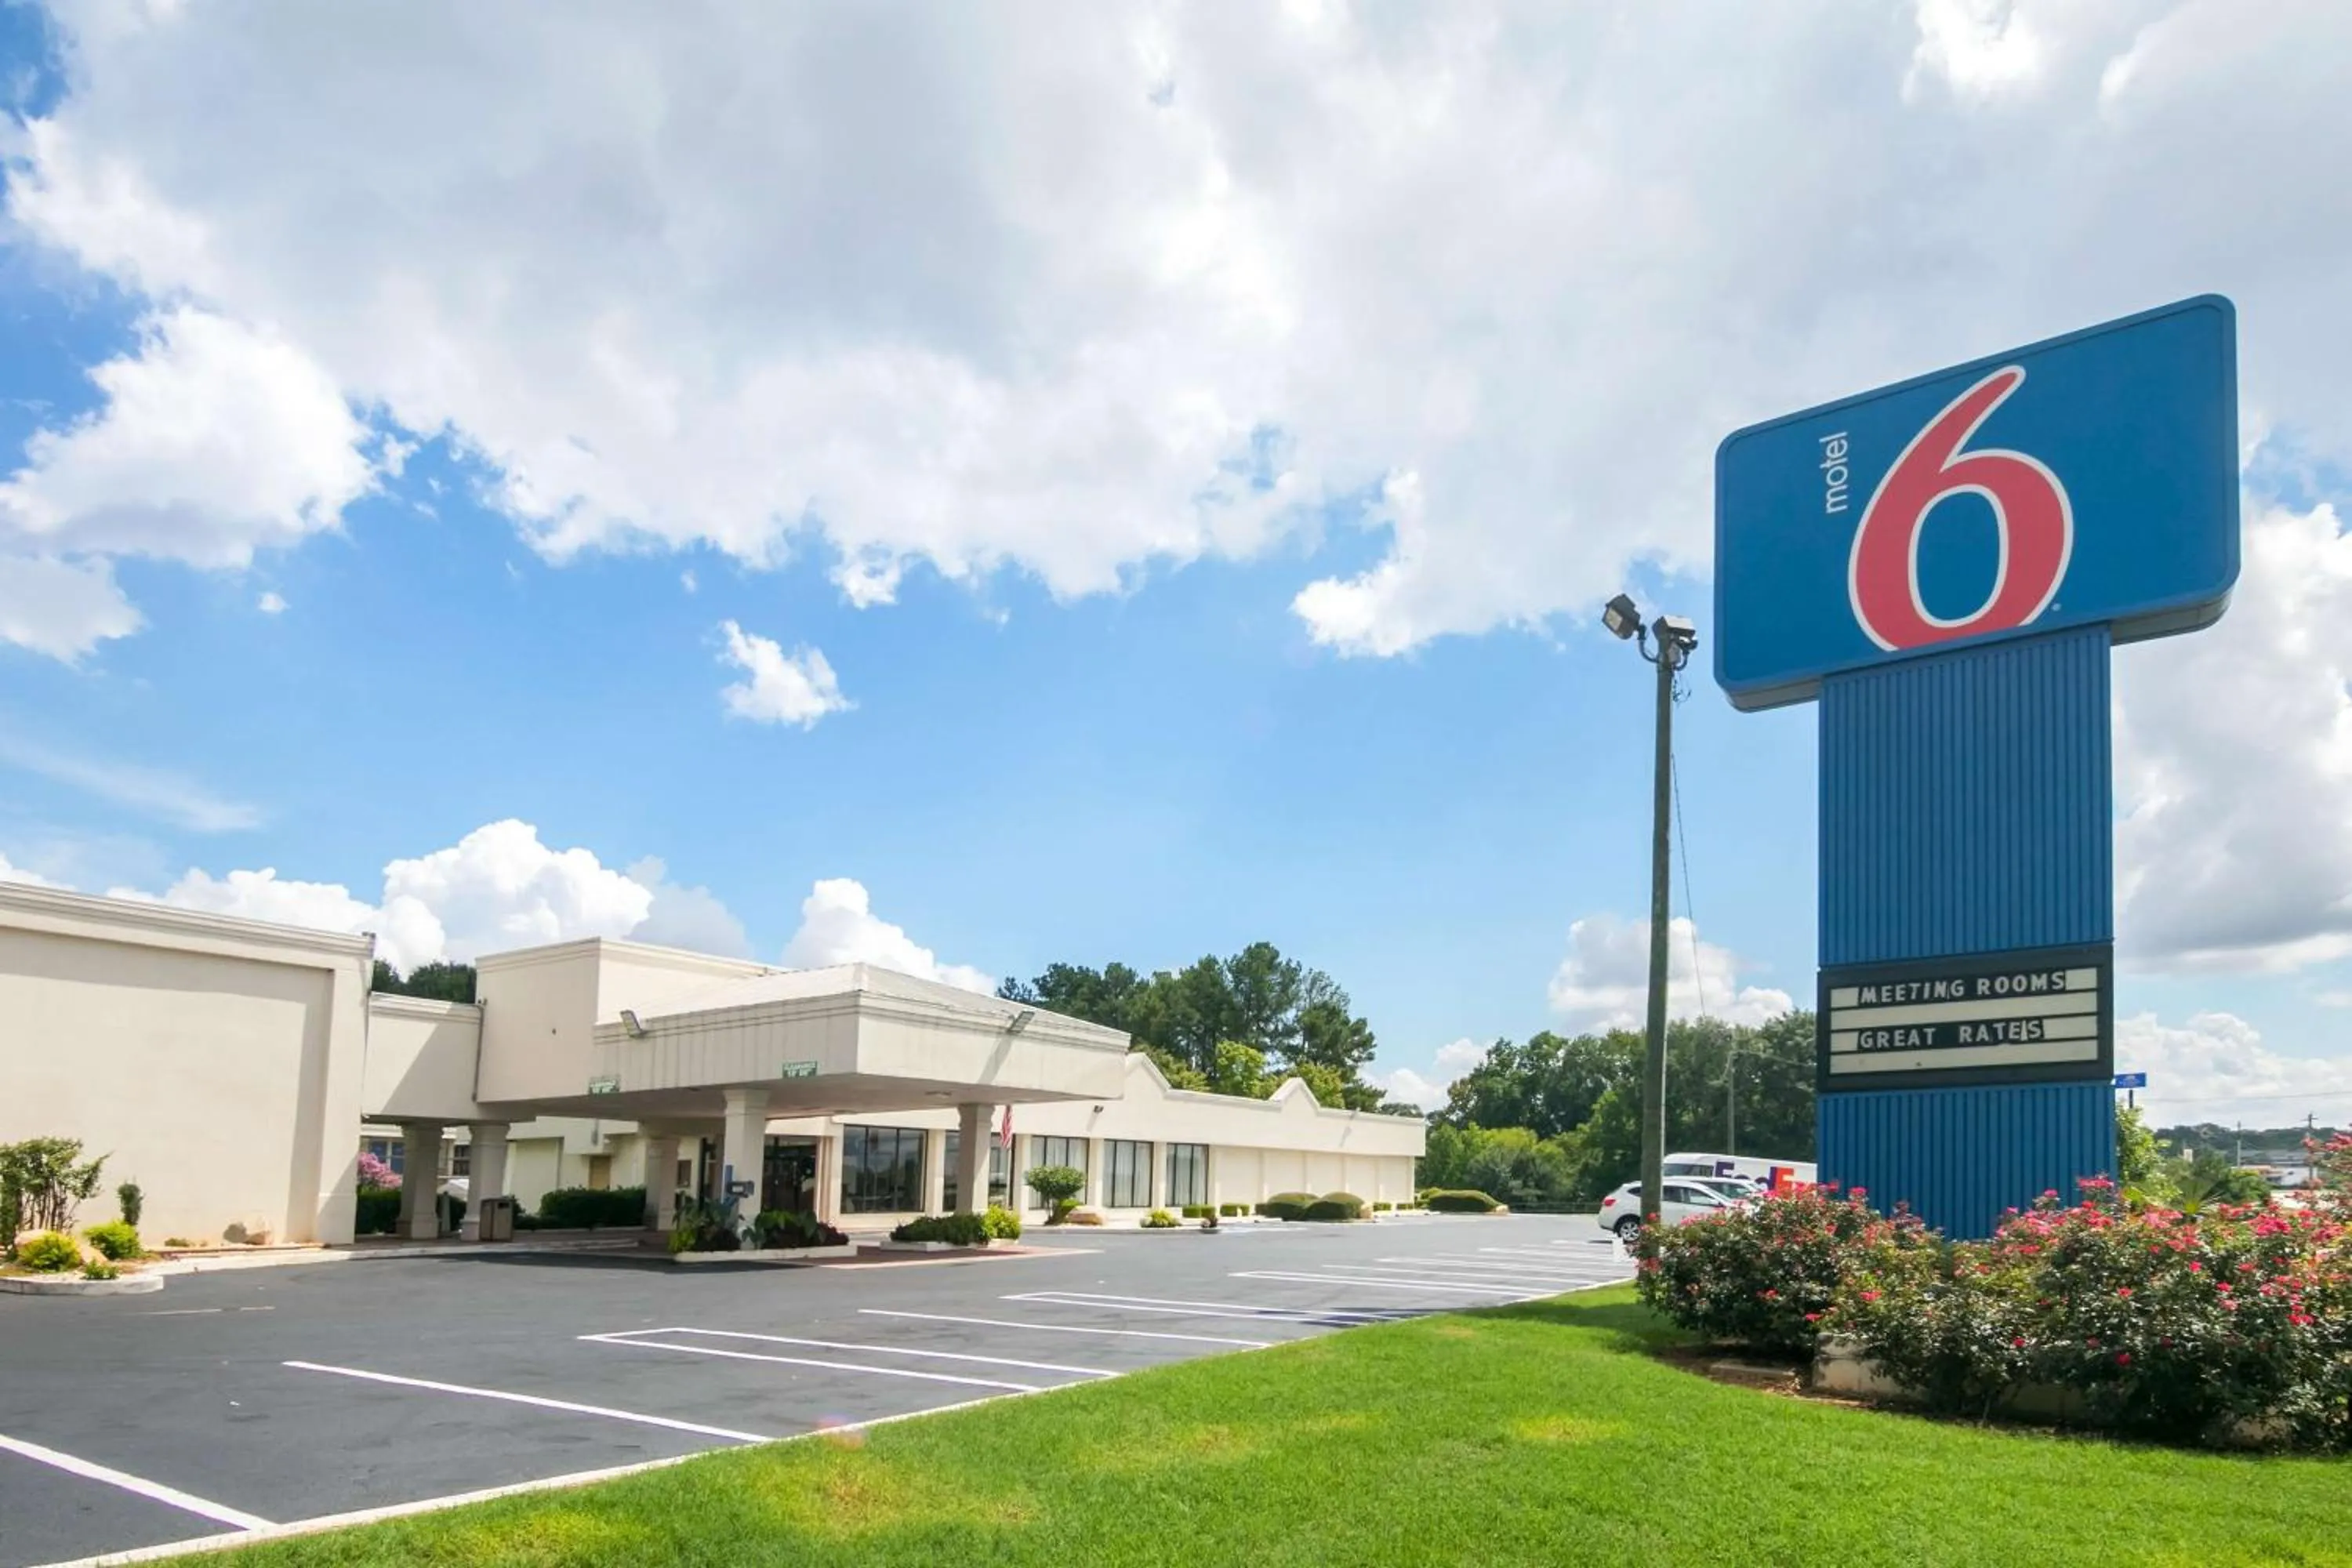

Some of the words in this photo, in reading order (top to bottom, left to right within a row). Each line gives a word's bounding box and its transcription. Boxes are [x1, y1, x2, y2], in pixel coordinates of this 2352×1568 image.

[1819, 430, 1848, 514] motel
[1848, 365, 2074, 652] 6
[1860, 979, 1965, 1004] MEETING
[1977, 971, 2065, 995] ROOMS
[1860, 1028, 1936, 1049] GREAT
[1959, 1020, 2041, 1043] RATES
